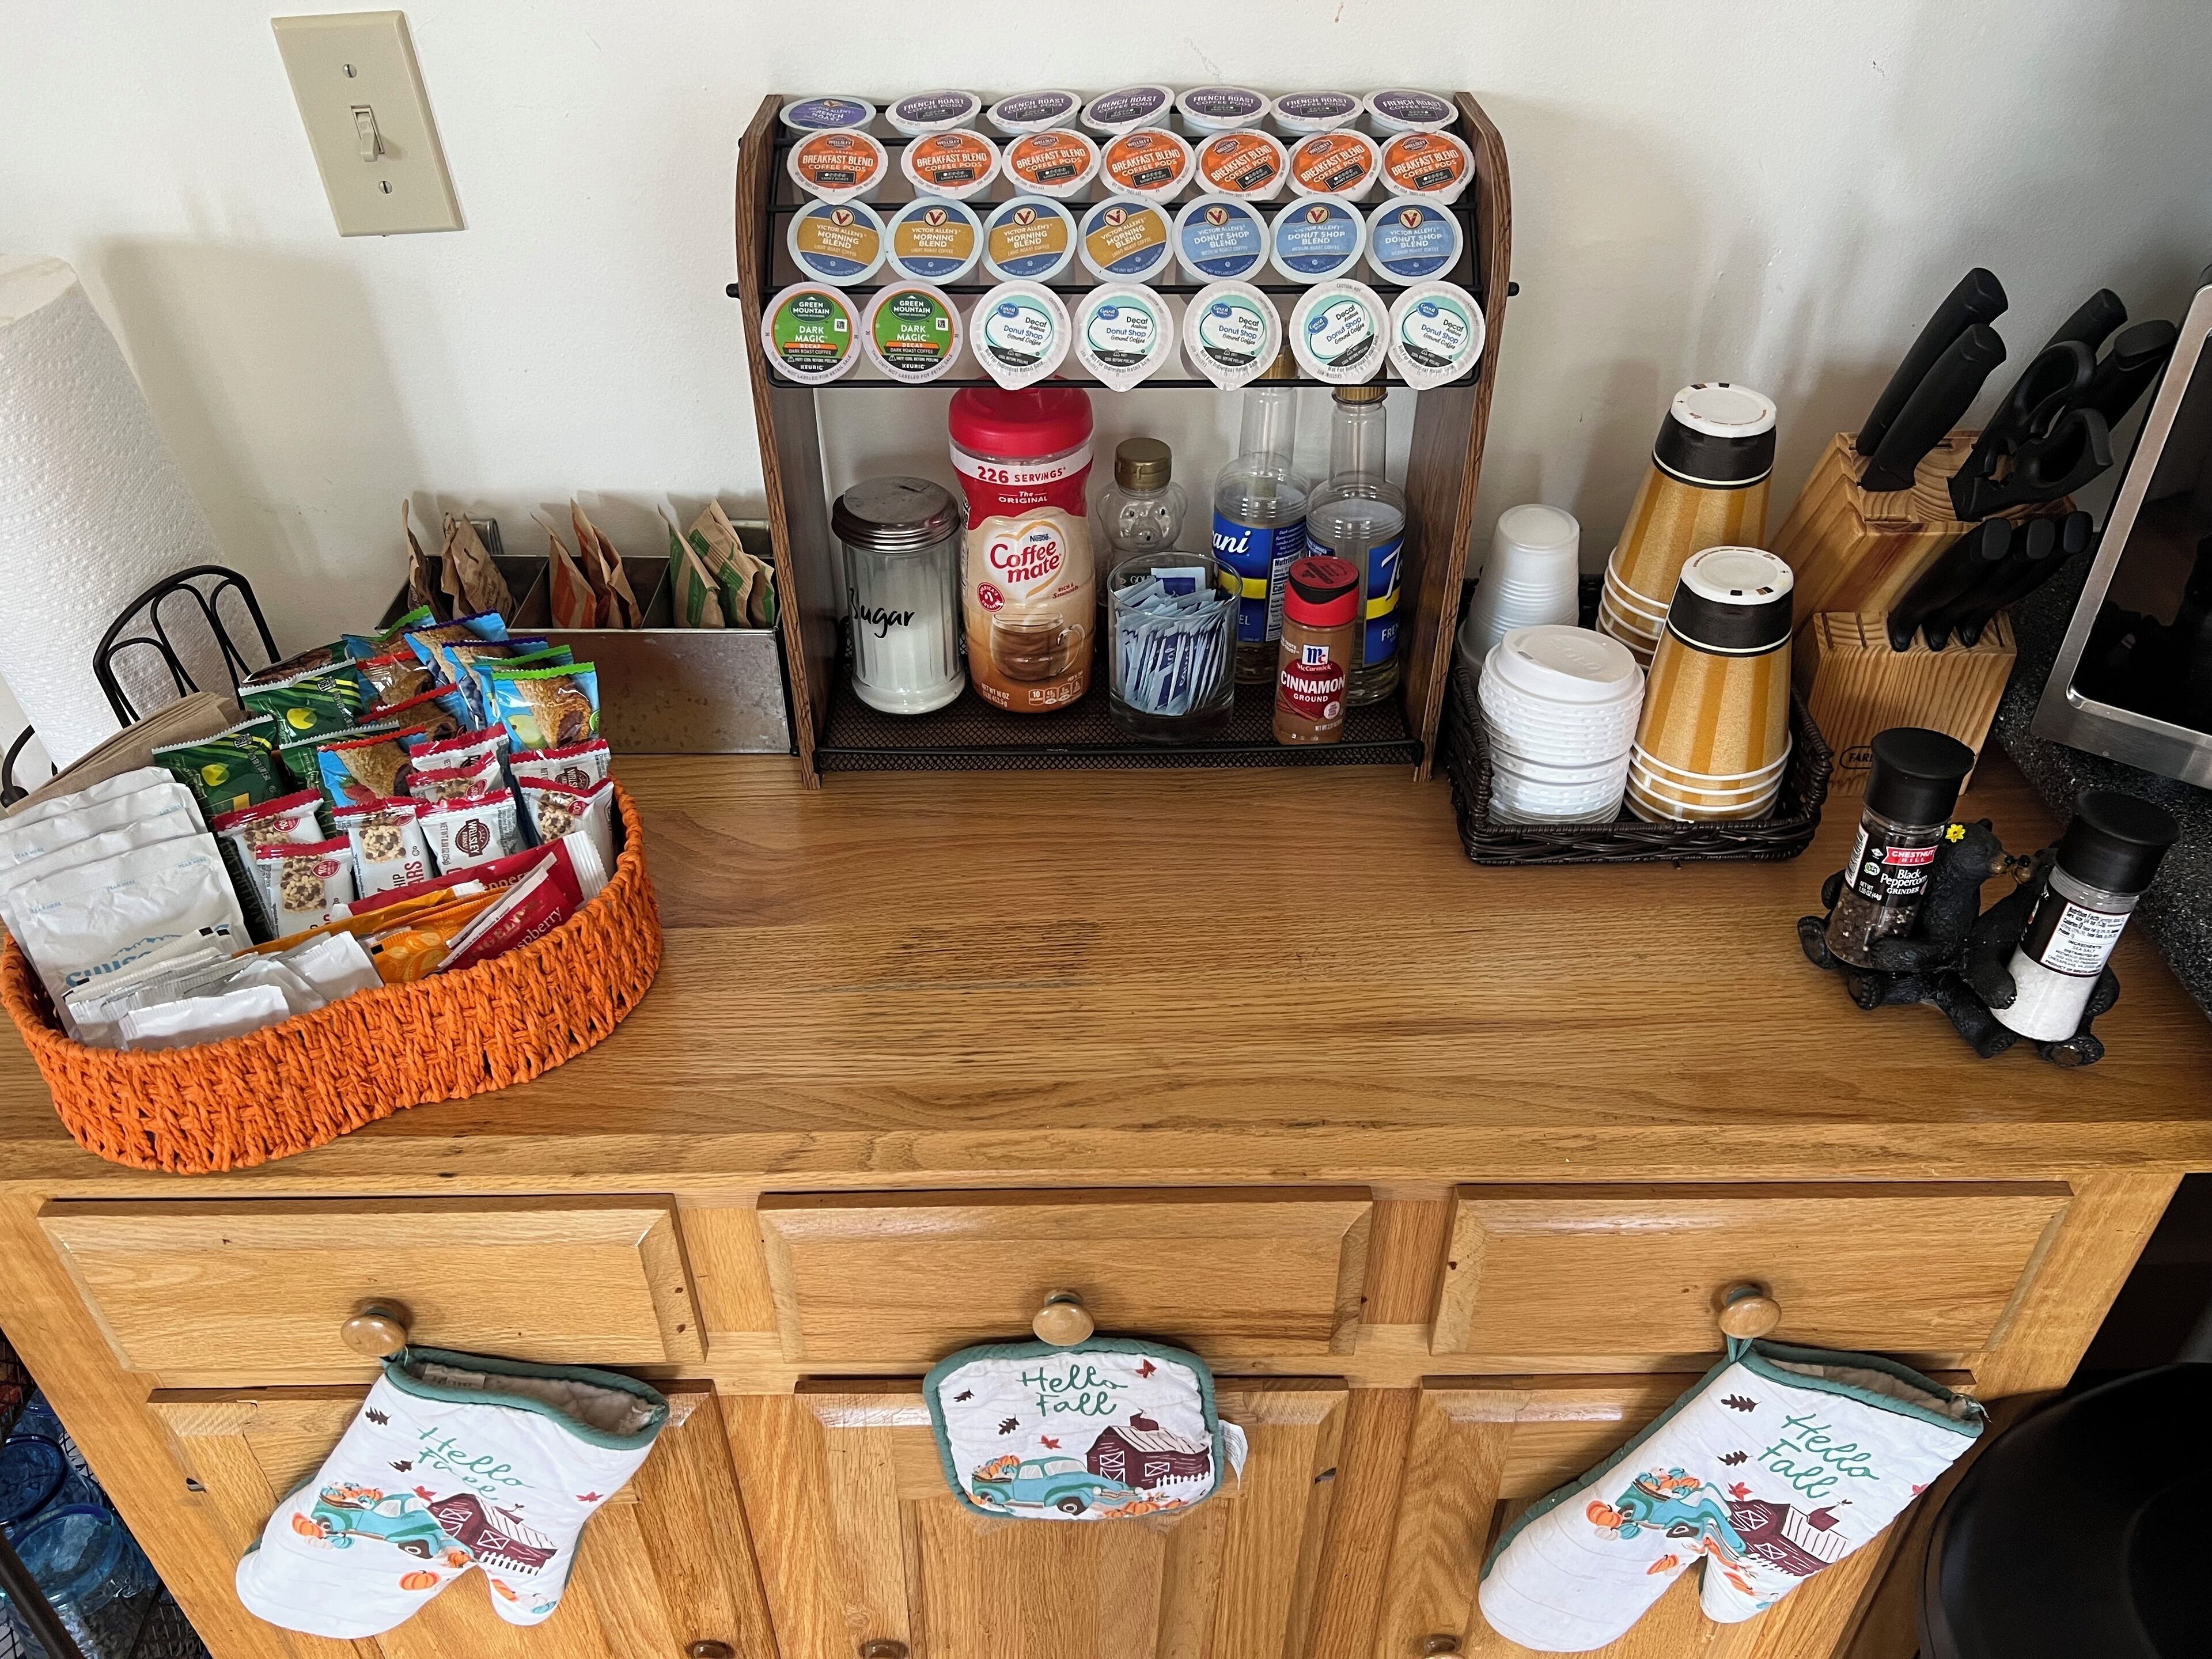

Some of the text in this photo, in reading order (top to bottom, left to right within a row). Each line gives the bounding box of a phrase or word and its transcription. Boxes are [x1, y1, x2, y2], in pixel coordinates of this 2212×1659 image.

[904, 100, 935, 111] FRENCH
[1005, 101, 1035, 112] FRENCH
[1097, 99, 1129, 110] FRENCH
[1228, 96, 1253, 104] ROAST
[1382, 100, 1414, 109] FRENCH
[802, 155, 873, 166] BREAKFAST BLEND
[916, 153, 987, 167] BREAKFAST BLEND
[1016, 149, 1086, 168] BREAKFAST BLEND
[1112, 149, 1181, 173] BREAKFAST BLEND
[1210, 145, 1272, 181] BREAKFAST BLEND
[1300, 145, 1365, 181] BREAKFAST BLEND
[1391, 150, 1459, 176] BREAKFAST BLEND
[843, 164, 866, 172] PODS
[925, 163, 958, 172] COFFEE
[1025, 162, 1058, 172] COFFEE
[1122, 159, 1177, 176] COFFEE PODS
[1224, 155, 1272, 183] COFFEE PODS
[1313, 154, 1365, 183] COFFEE PODS
[1403, 159, 1456, 179] COFFEE PODS
[817, 224, 840, 233] VICTOR
[1004, 228, 1025, 236] VICTOR
[1101, 228, 1123, 240] VICTOR
[1107, 225, 1145, 246] MORNING
[817, 231, 859, 245] MORNING
[1007, 231, 1047, 243] MORNING
[1014, 238, 1041, 248] BLEND
[1115, 233, 1142, 249] BLEND
[1194, 234, 1224, 244] DONUT
[1288, 232, 1318, 240] DONUT
[1385, 236, 1415, 244] DONUT
[823, 239, 851, 249] BLEND
[1210, 239, 1237, 248] BLEND
[1336, 304, 1356, 320] Decaf
[1025, 317, 1047, 327] Decaf
[1126, 316, 1148, 324] Decaf
[1238, 317, 1259, 326] Decaf
[1443, 319, 1464, 332] Decaf
[1004, 325, 1043, 340] Donut Shop
[1107, 327, 1146, 338] Donut Shop
[1218, 325, 1257, 339] Donut Shop
[1327, 317, 1362, 342] Donut Shop
[1421, 324, 1459, 344] Donut Shop
[978, 466, 1009, 483] 226
[1213, 531, 1251, 553] ani
[990, 541, 1057, 569] Coffee
[1007, 554, 1060, 583] mate
[1052, 585, 1078, 599] Smooth
[850, 588, 915, 638] Sugar
[1297, 663, 1331, 672] McCormick
[1281, 670, 1345, 694] CINNAMON
[1293, 693, 1328, 702] GROUND
[1892, 850, 1934, 858] CHESTNUT
[1880, 873, 1927, 888] Peppercorn
[1897, 869, 1921, 879] Black
[1887, 887, 1919, 895] GRINDER
[1016, 1364, 1128, 1392] Hello
[1036, 1392, 1117, 1416] Fall
[1781, 1414, 1880, 1480] Hello
[417, 1427, 535, 1488] Hello
[1758, 1439, 1838, 1498] Fall
